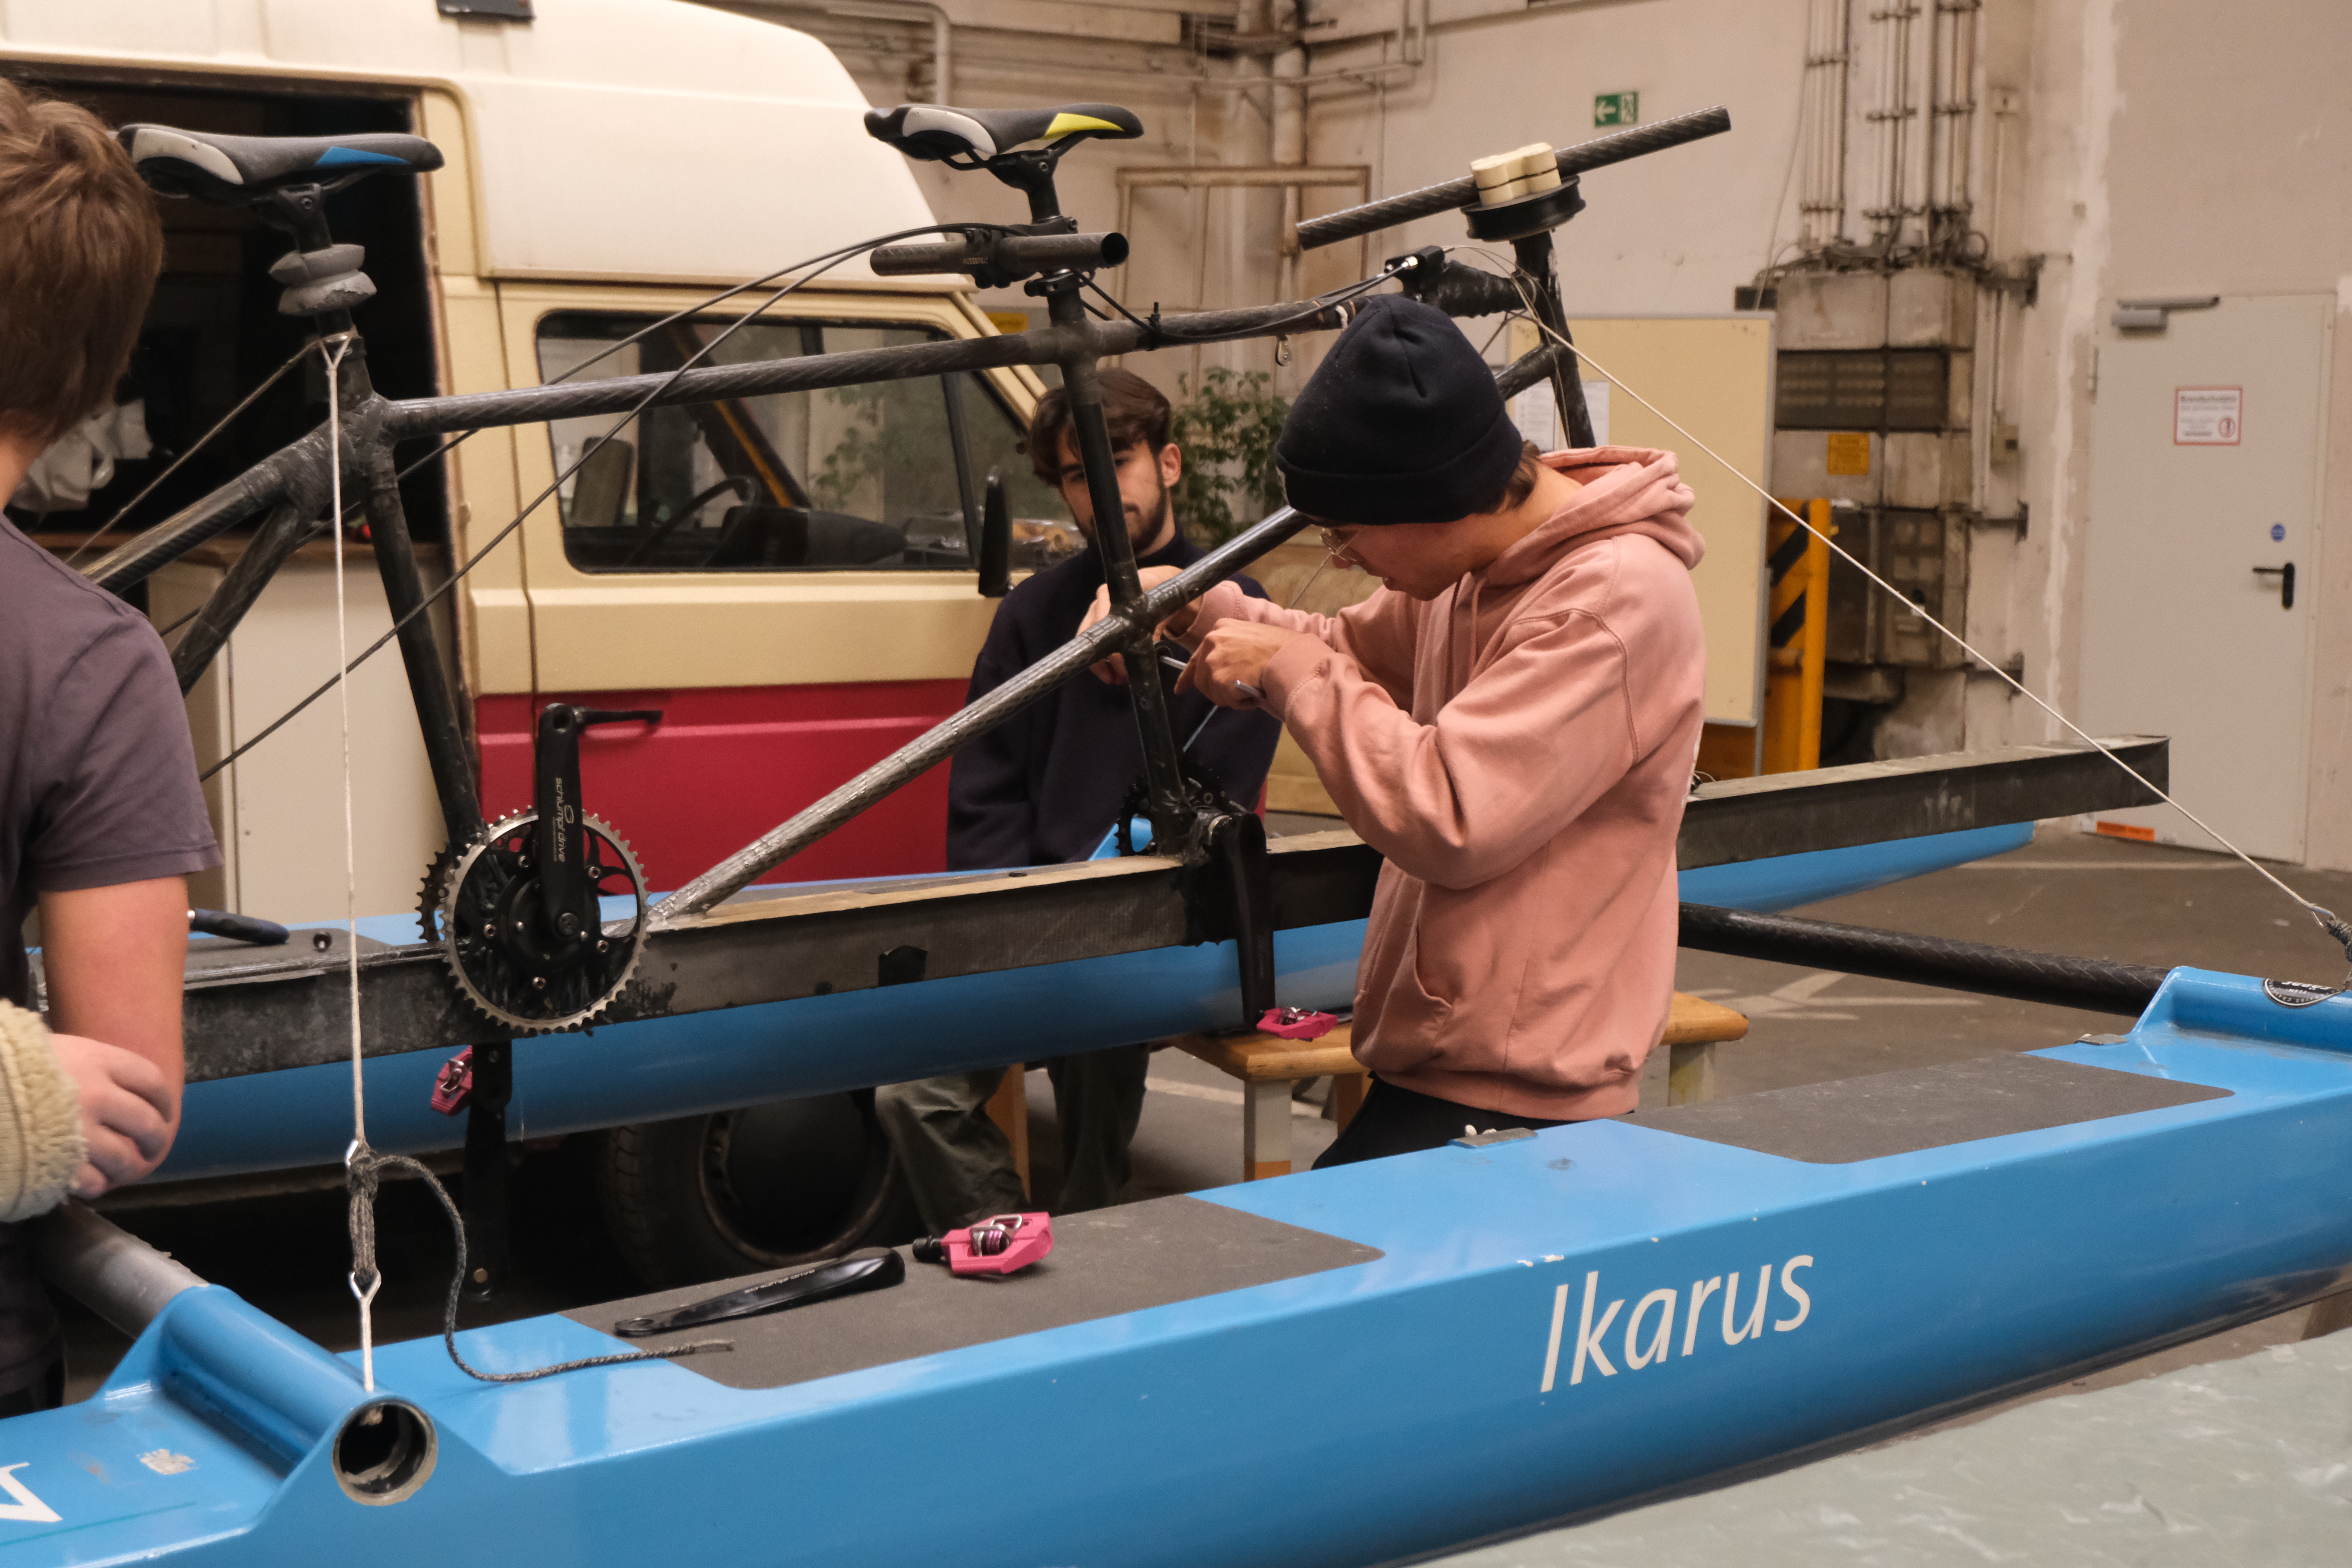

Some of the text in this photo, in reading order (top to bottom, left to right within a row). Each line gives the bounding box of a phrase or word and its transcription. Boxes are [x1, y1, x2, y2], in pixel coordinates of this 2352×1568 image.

[556, 777, 567, 862] schlumpf drive
[1540, 1254, 1814, 1393] Ikarus
